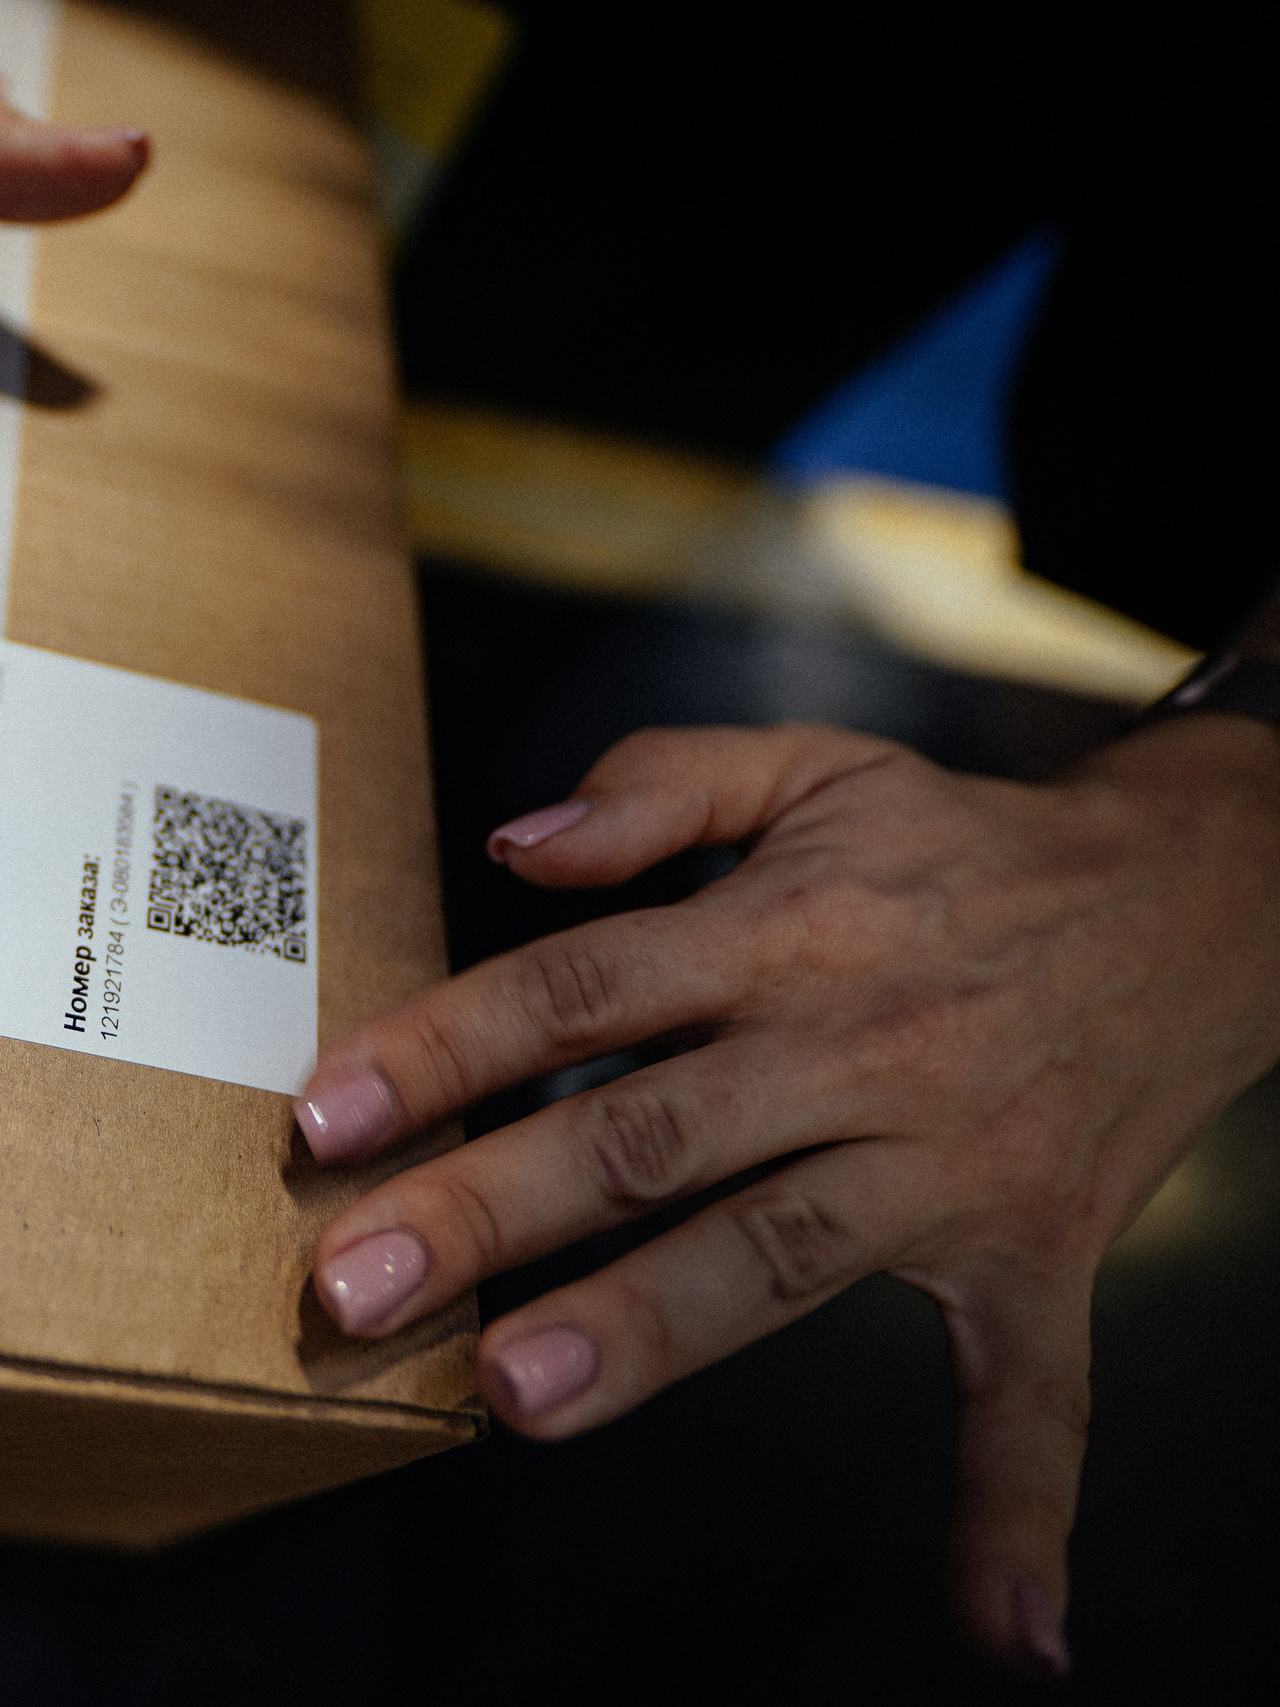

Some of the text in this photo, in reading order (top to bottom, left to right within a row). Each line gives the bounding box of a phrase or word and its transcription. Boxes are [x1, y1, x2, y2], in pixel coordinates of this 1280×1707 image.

[63, 853, 100, 1033] Номер заказа:
[100, 929, 125, 1041] 121921784
